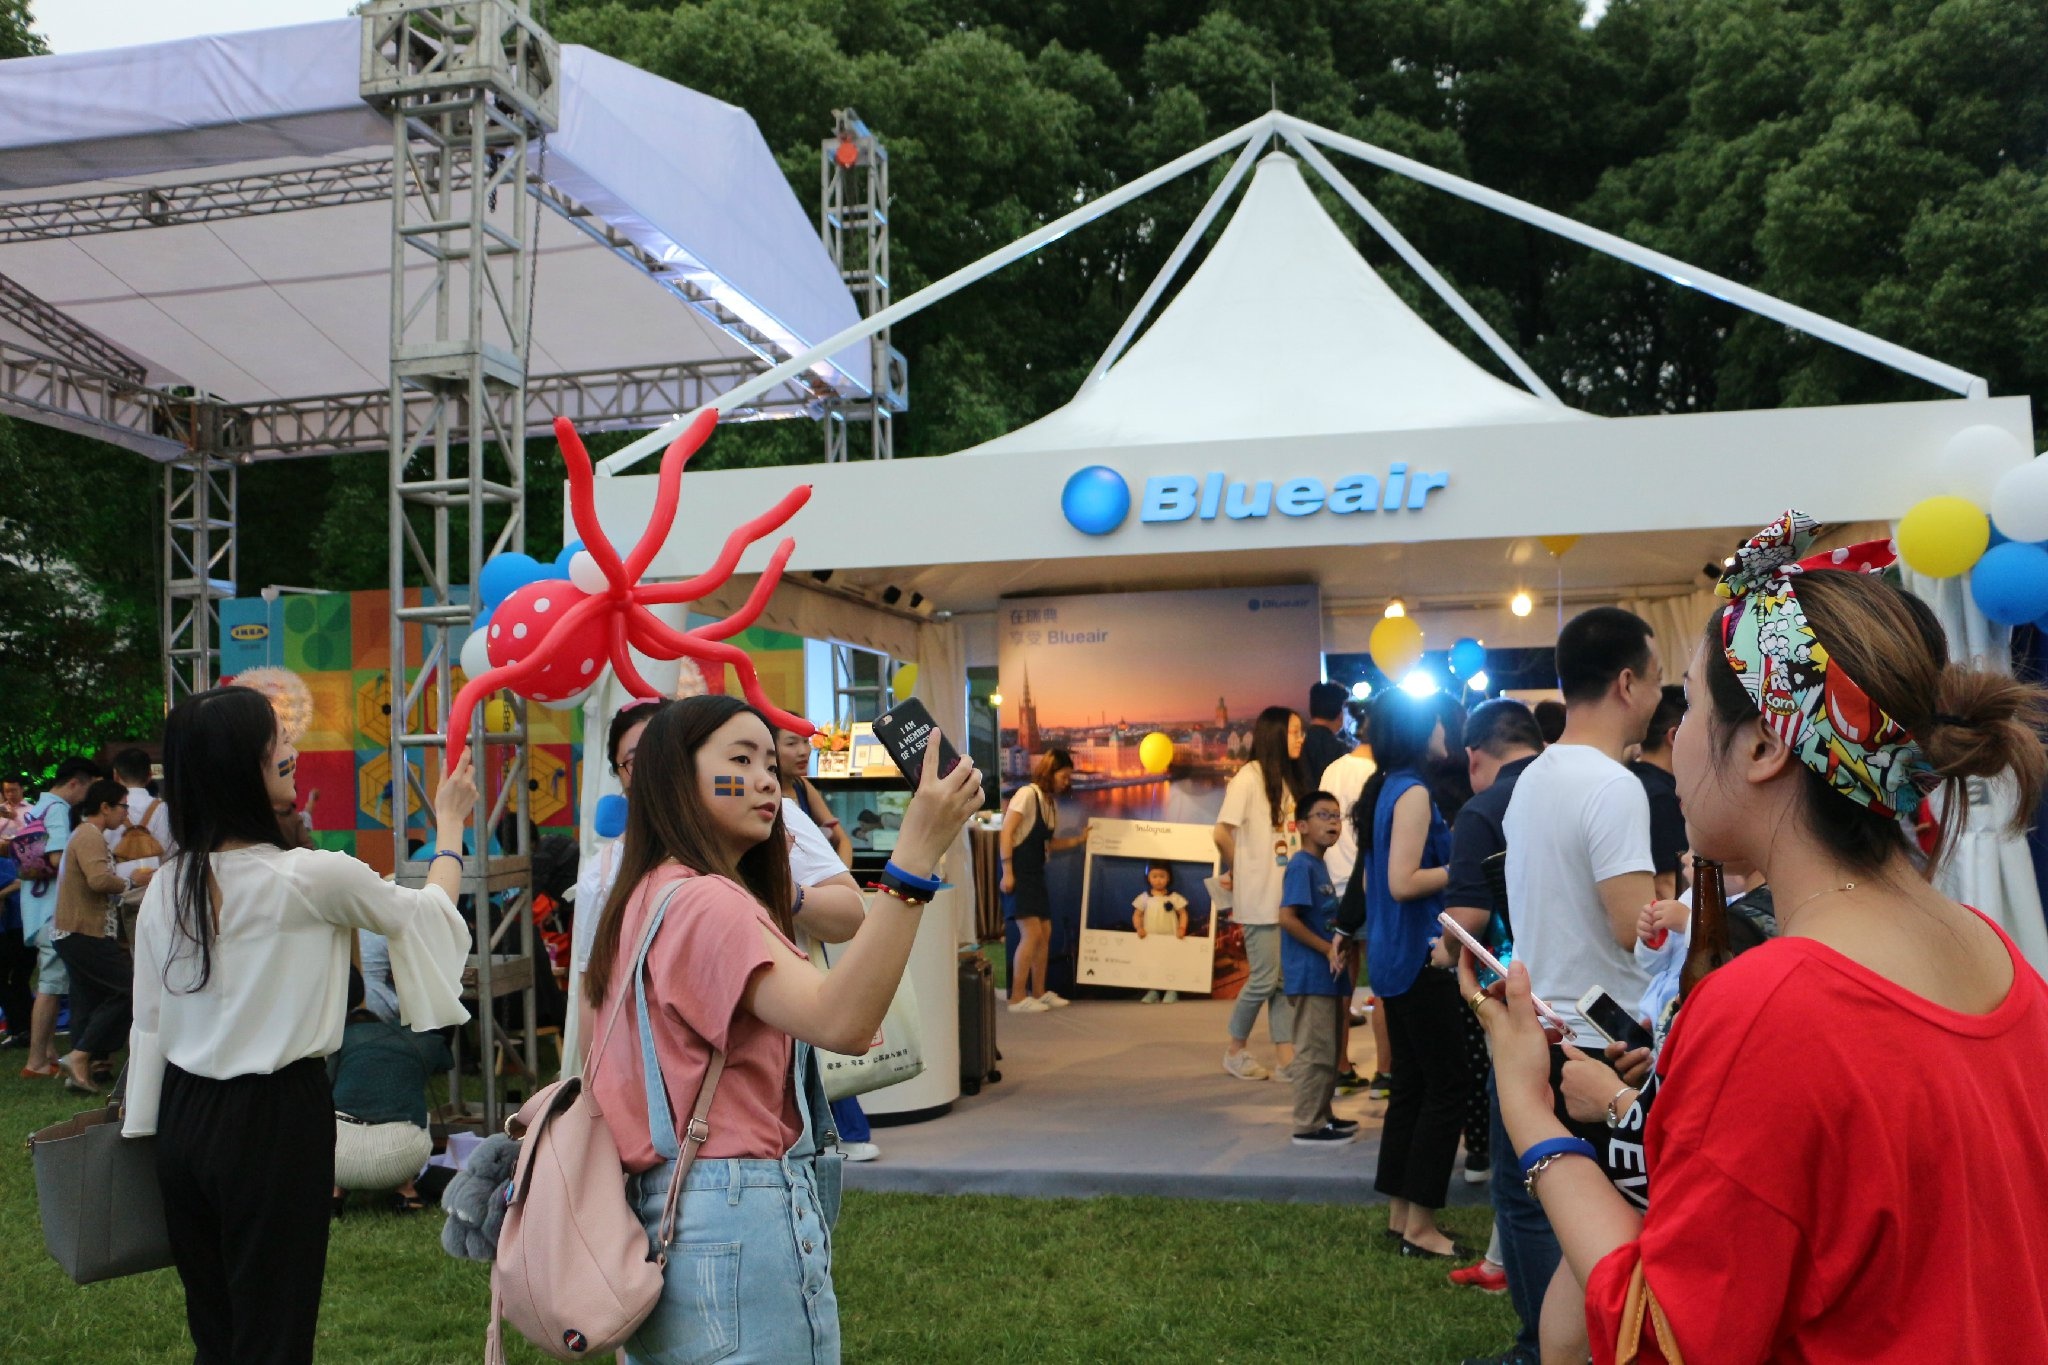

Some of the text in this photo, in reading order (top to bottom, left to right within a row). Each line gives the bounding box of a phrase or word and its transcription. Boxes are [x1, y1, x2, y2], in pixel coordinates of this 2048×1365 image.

[1140, 462, 1450, 523] Blueair
[1009, 608, 1057, 625] 在瑞典
[235, 628, 264, 636] IKEA
[1048, 628, 1108, 645] Blueair
[1766, 693, 1796, 710] Corn
[898, 723, 931, 749] A MEMBER
[899, 720, 917, 735] I AM
[901, 751, 910, 760] OF
[910, 746, 917, 754] A
